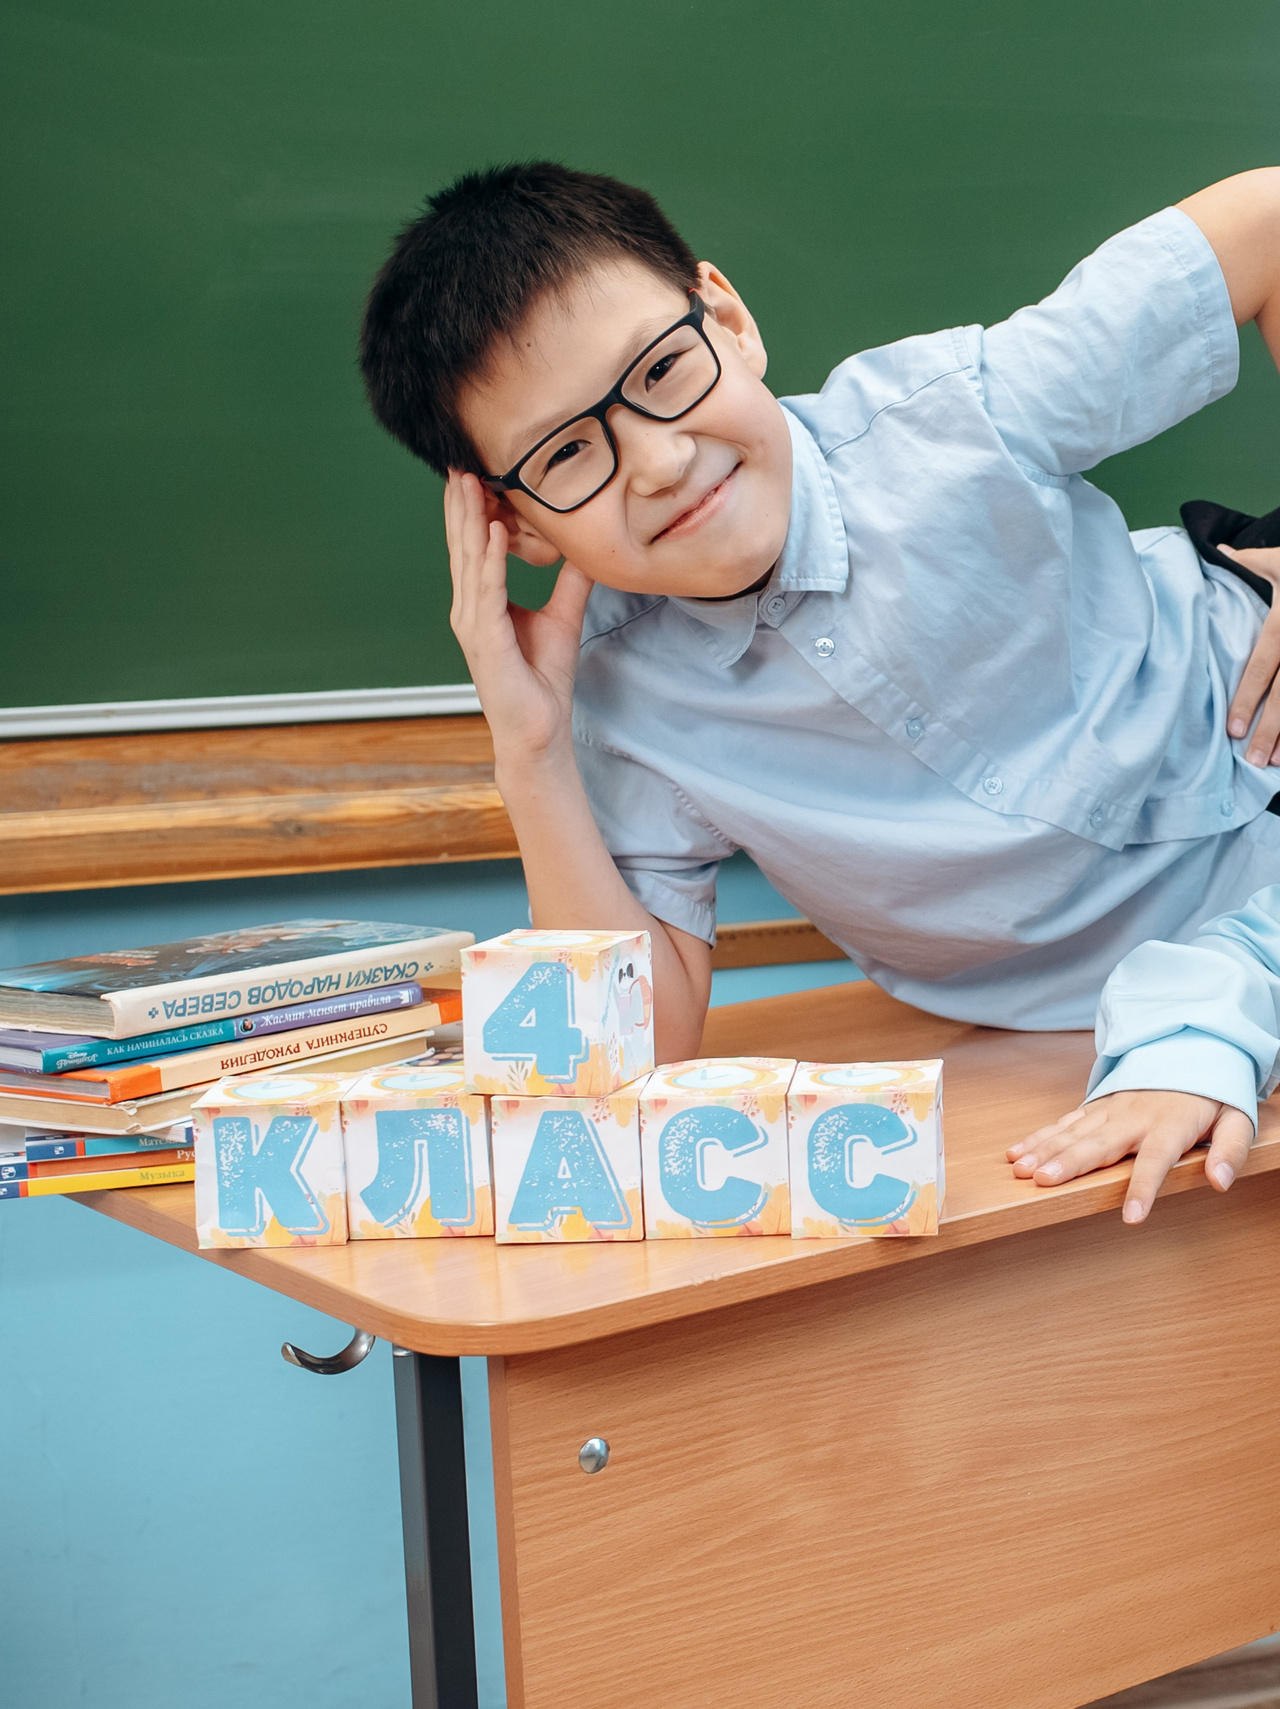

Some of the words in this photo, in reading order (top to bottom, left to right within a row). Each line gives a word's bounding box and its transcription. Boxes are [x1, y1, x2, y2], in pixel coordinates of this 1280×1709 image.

[347, 961, 419, 988] СКАЗКИ
[248, 973, 342, 1006] НАРОДОВ
[162, 991, 241, 1020] СЕВЕРА
[260, 1011, 305, 1028] Жасмин
[307, 1004, 347, 1020] меняет
[349, 994, 392, 1012] правила
[305, 1023, 388, 1050] СУПЕРКНИГА
[482, 962, 590, 1084] 4
[106, 1046, 125, 1056] КАК
[126, 1033, 189, 1052] НАЧИНАЛАСЬ
[189, 1027, 224, 1040] СКАЗКА
[220, 1043, 301, 1070] РУКОДЕЛИЯ
[139, 1169, 186, 1182] Музыка
